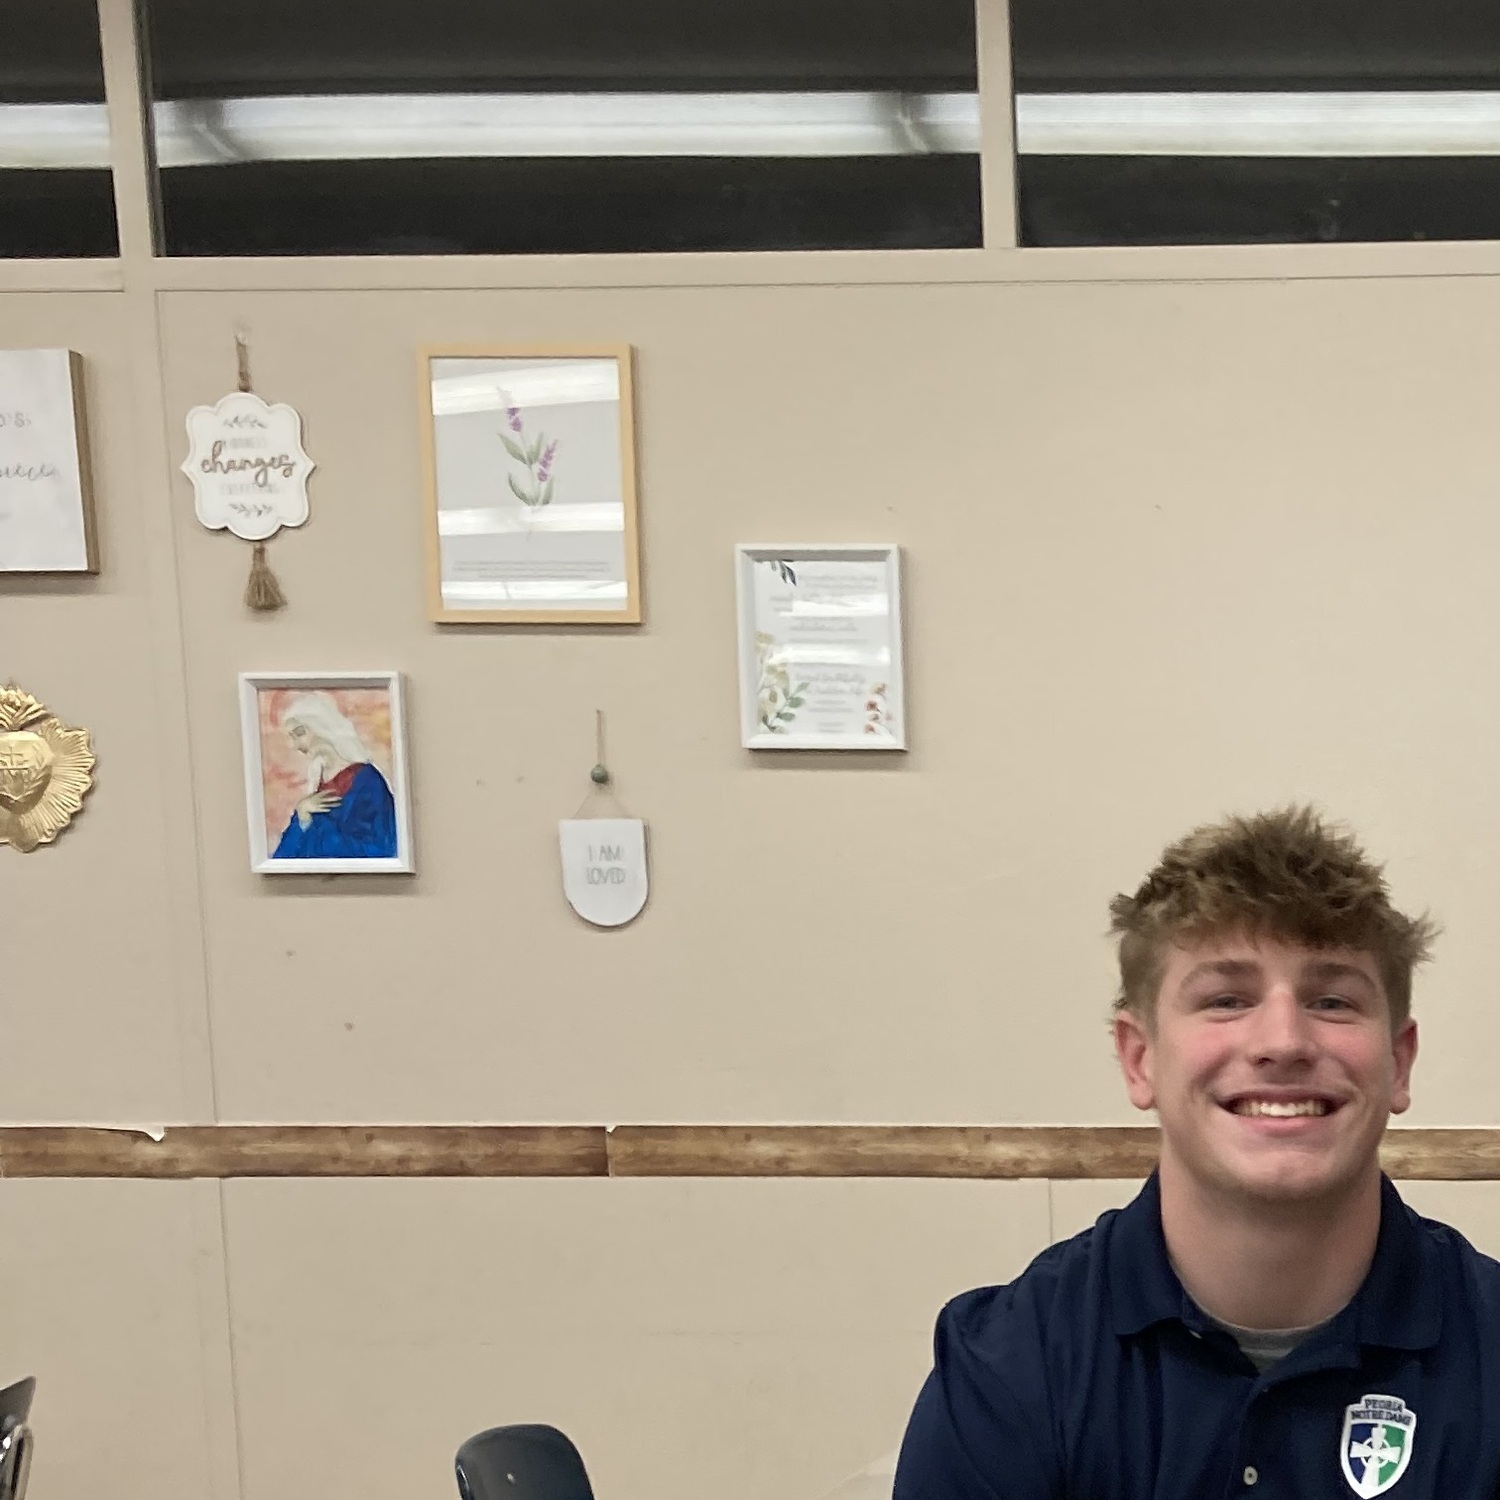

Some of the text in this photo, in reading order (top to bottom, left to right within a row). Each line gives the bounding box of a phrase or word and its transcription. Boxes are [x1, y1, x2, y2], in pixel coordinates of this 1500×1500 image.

[201, 440, 296, 487] changes
[599, 844, 623, 862] AM
[585, 866, 627, 885] LOVED
[1364, 1398, 1403, 1413] PEORIA
